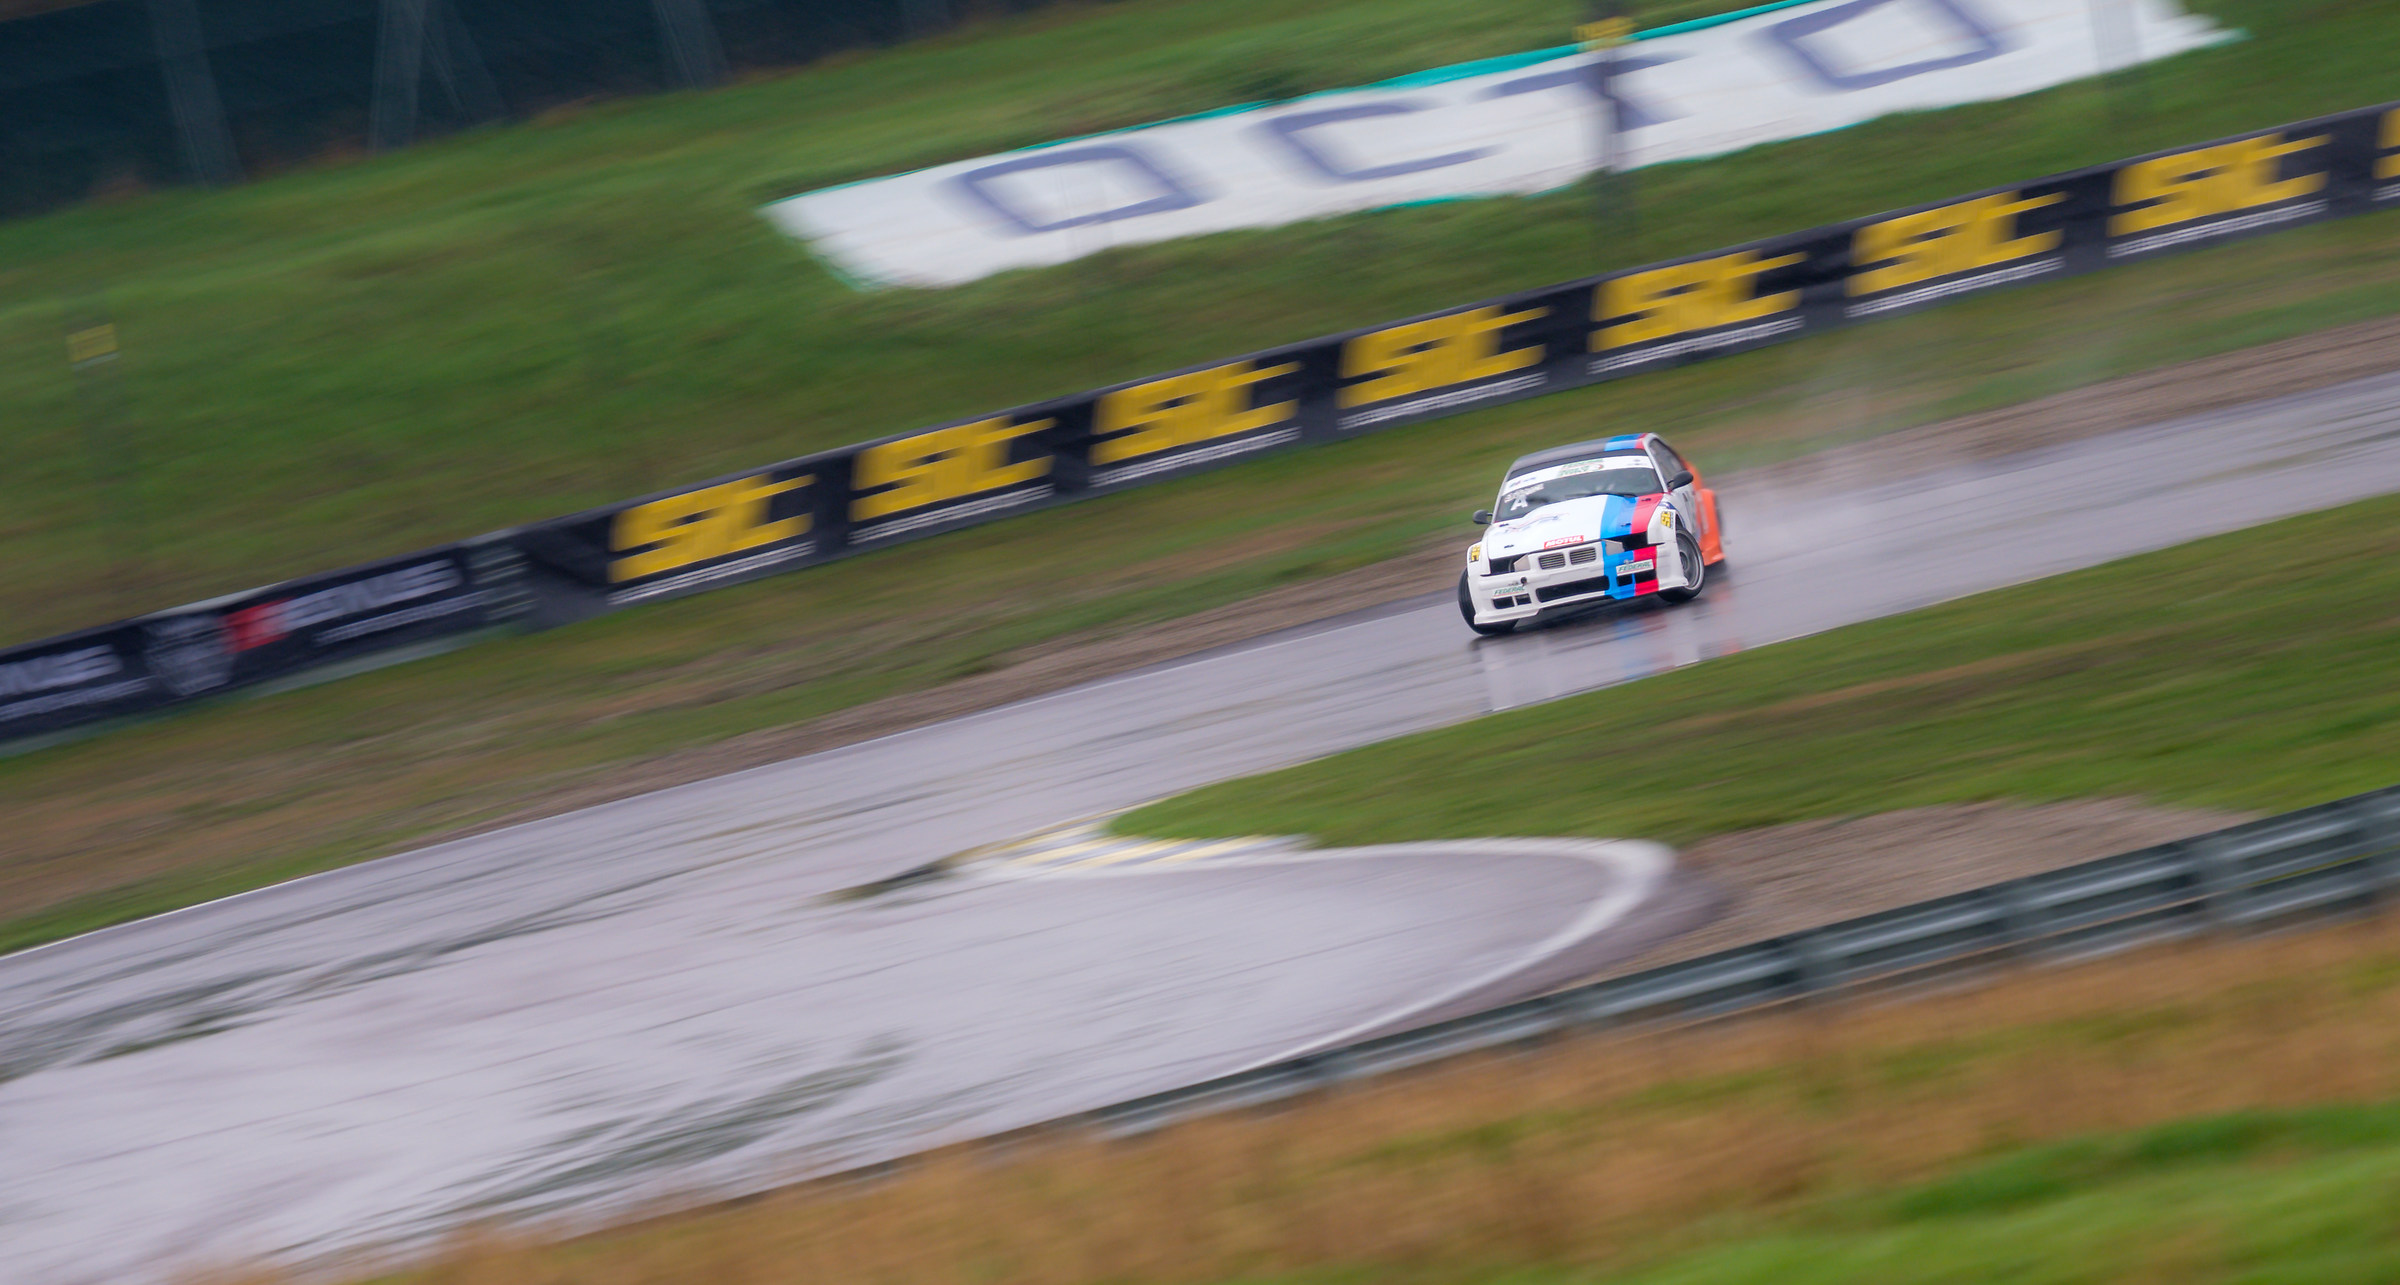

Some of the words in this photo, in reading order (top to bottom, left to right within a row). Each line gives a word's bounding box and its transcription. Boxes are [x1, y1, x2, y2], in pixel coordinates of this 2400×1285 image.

[1545, 535, 1584, 548] MOTUL
[1617, 561, 1652, 573] FEDERAL
[1494, 584, 1526, 595] FEDERAL
